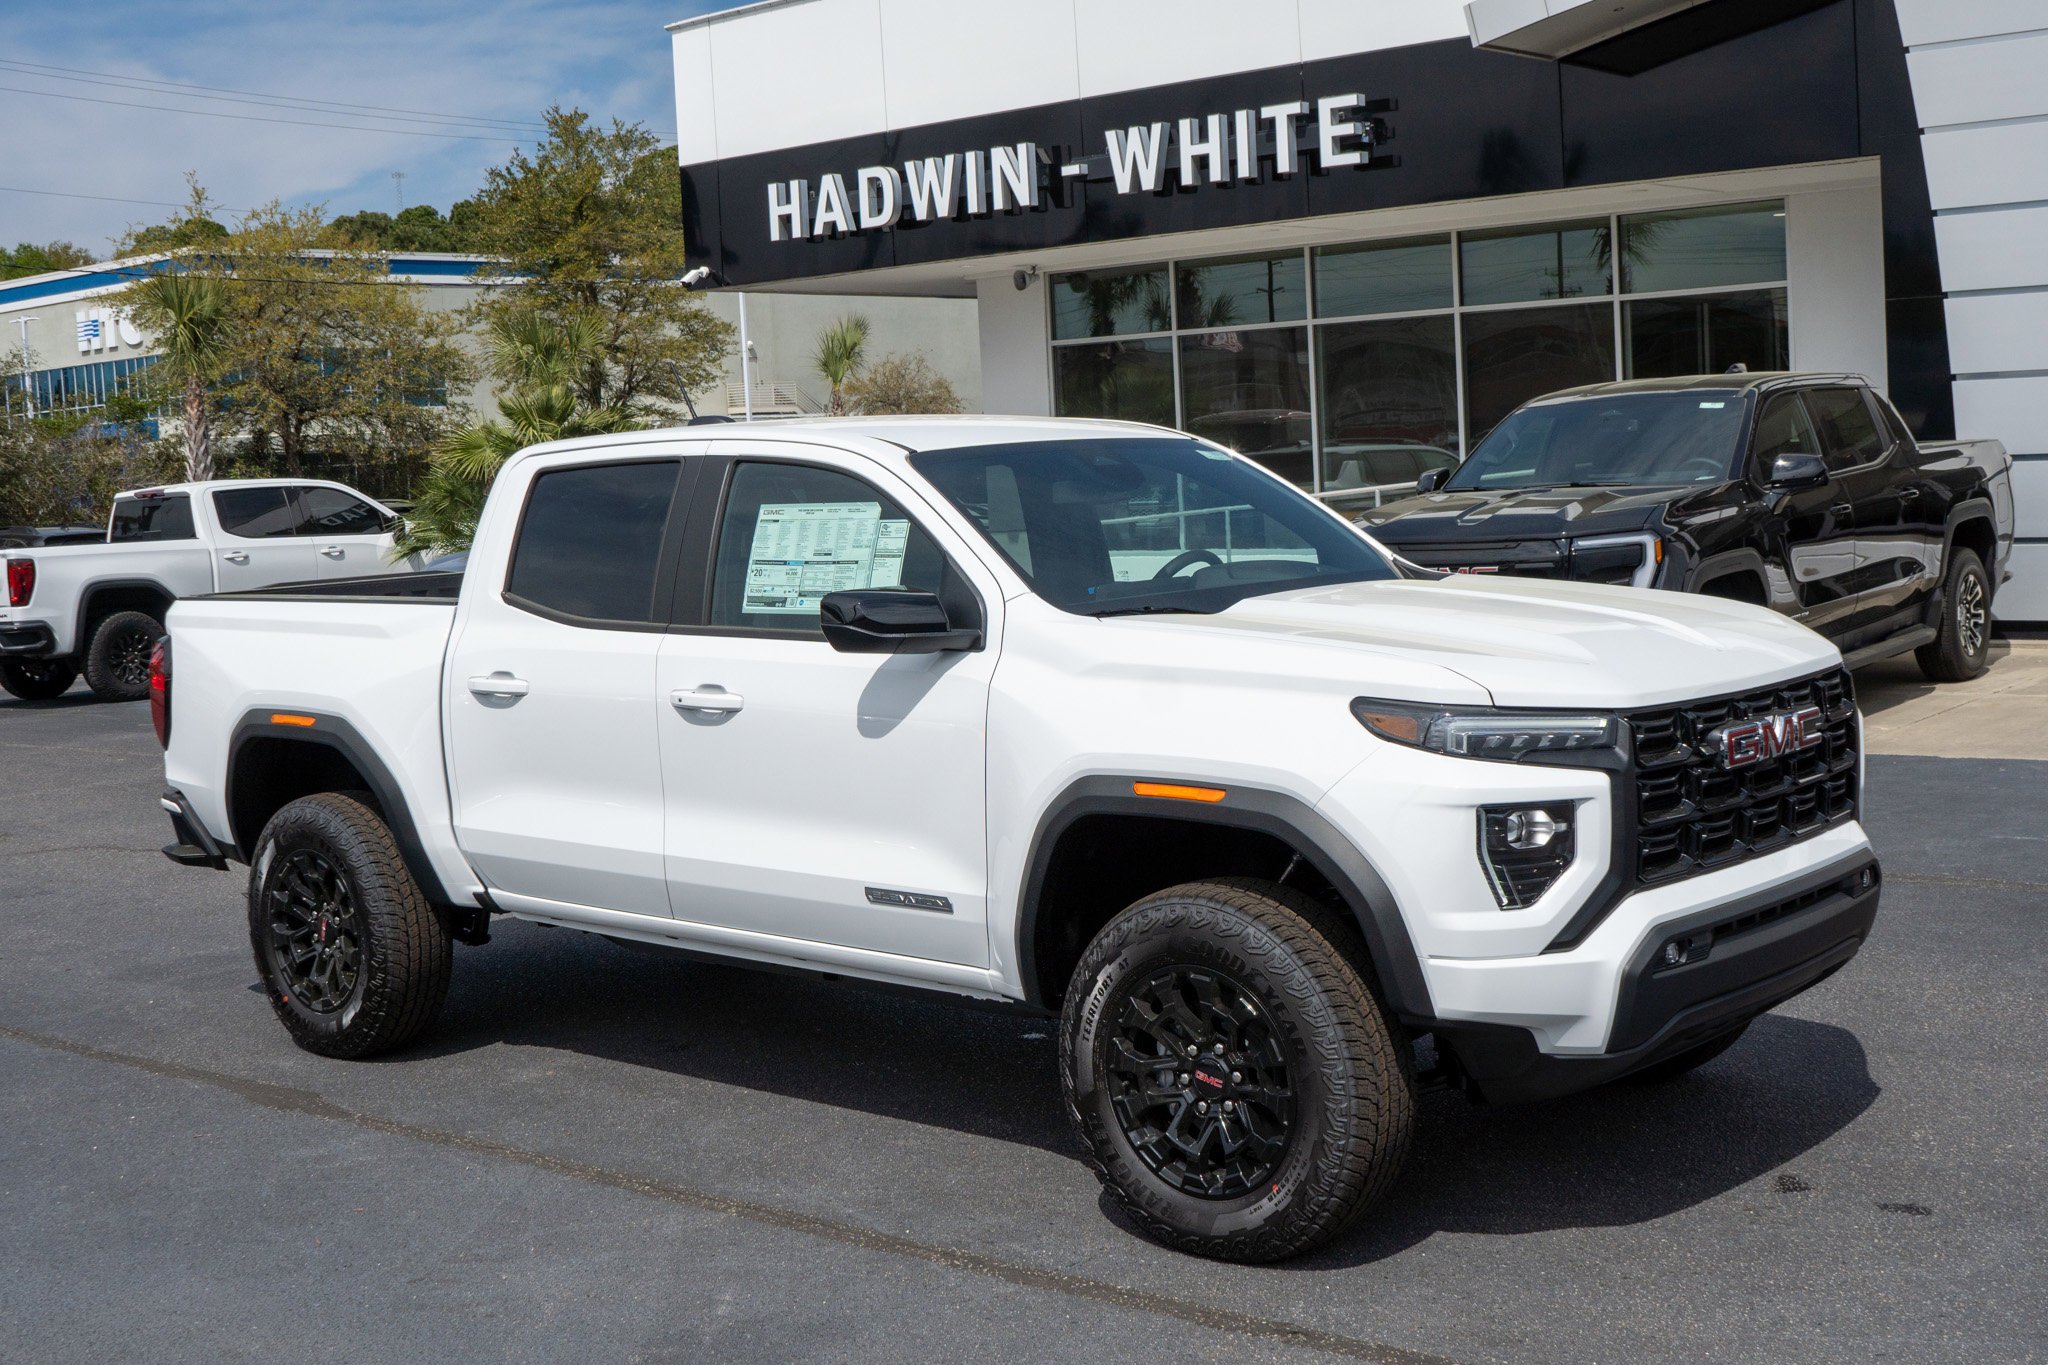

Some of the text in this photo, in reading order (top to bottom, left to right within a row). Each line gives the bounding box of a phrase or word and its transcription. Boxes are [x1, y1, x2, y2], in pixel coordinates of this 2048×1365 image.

[768, 143, 1038, 242] HADWIN
[1105, 93, 1369, 194] WHITE
[754, 568, 763, 577] 20
[1722, 706, 1823, 770] GMC
[1082, 957, 1130, 1042] TERRITORY AT
[1195, 1069, 1223, 1089] GMC
